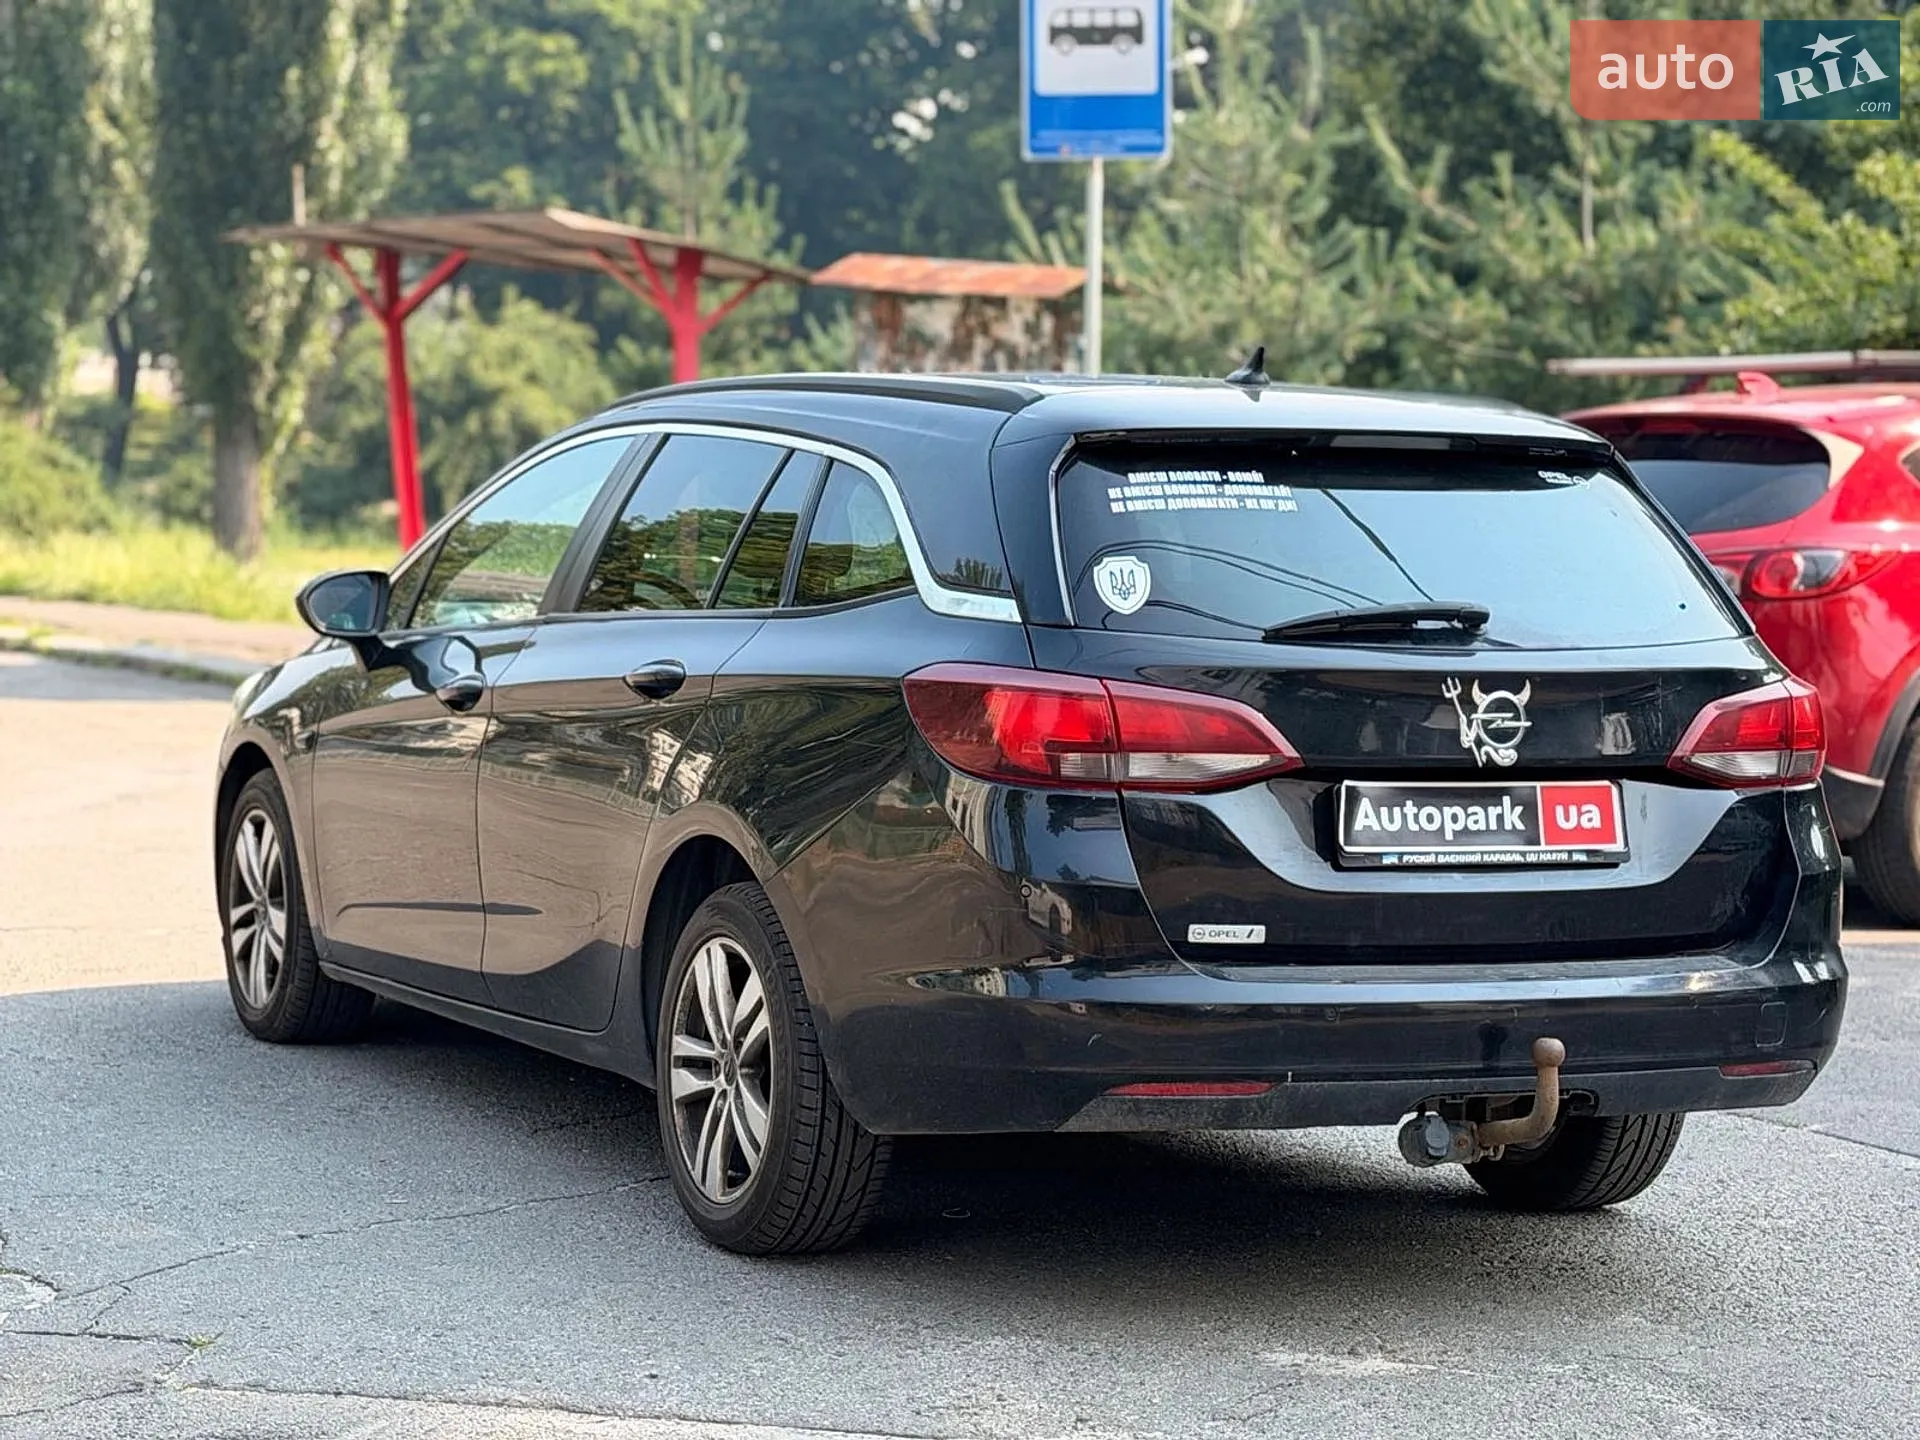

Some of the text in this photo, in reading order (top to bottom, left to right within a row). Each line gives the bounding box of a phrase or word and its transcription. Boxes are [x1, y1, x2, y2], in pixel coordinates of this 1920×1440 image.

[1354, 795, 1601, 841] Autopark ua
[1208, 929, 1240, 939] OPEL
